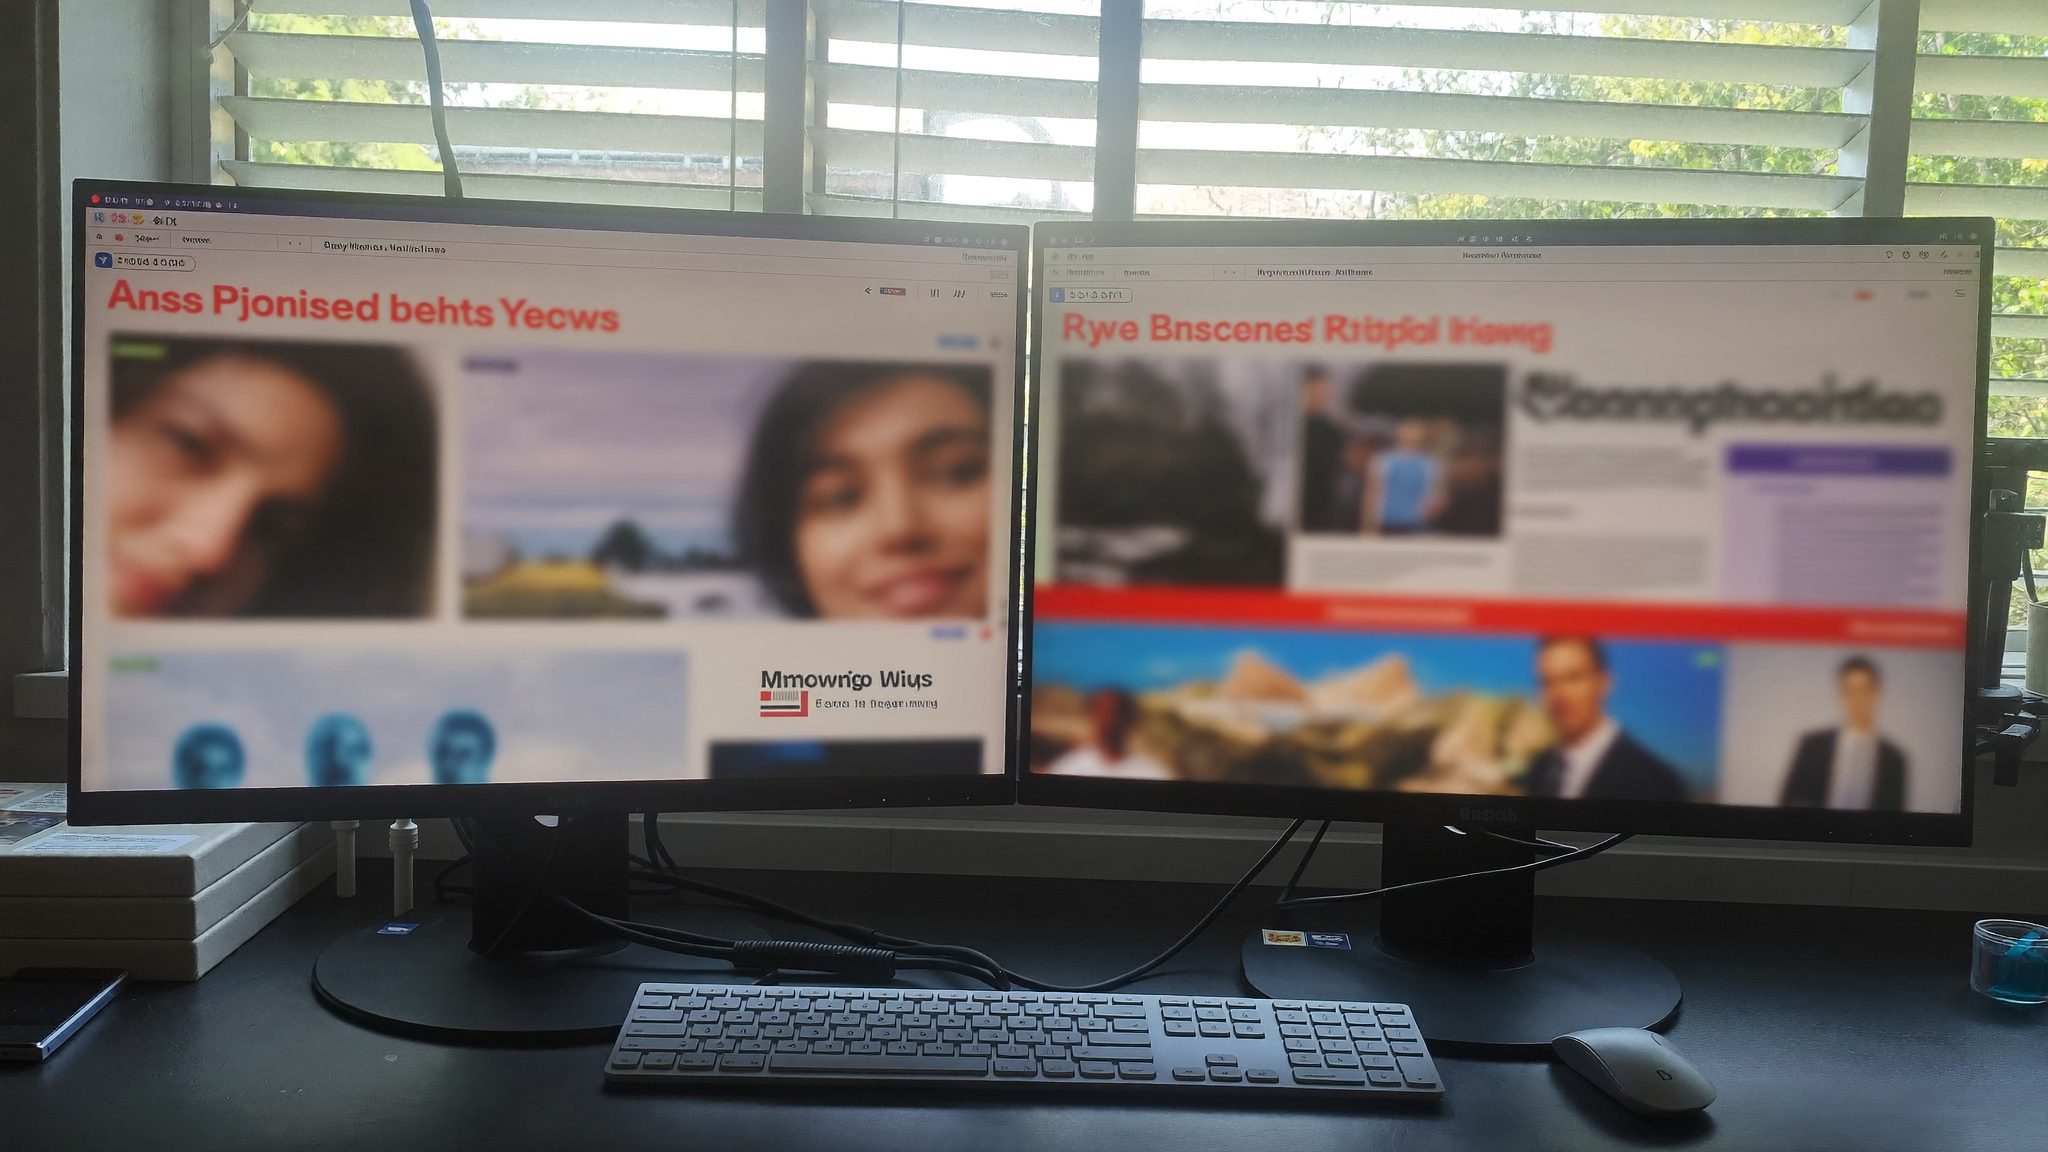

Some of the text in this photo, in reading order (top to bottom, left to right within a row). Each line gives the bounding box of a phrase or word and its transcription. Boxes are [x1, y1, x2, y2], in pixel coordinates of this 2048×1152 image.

[106, 278, 622, 334] Anss Pjonised behts Yecws
